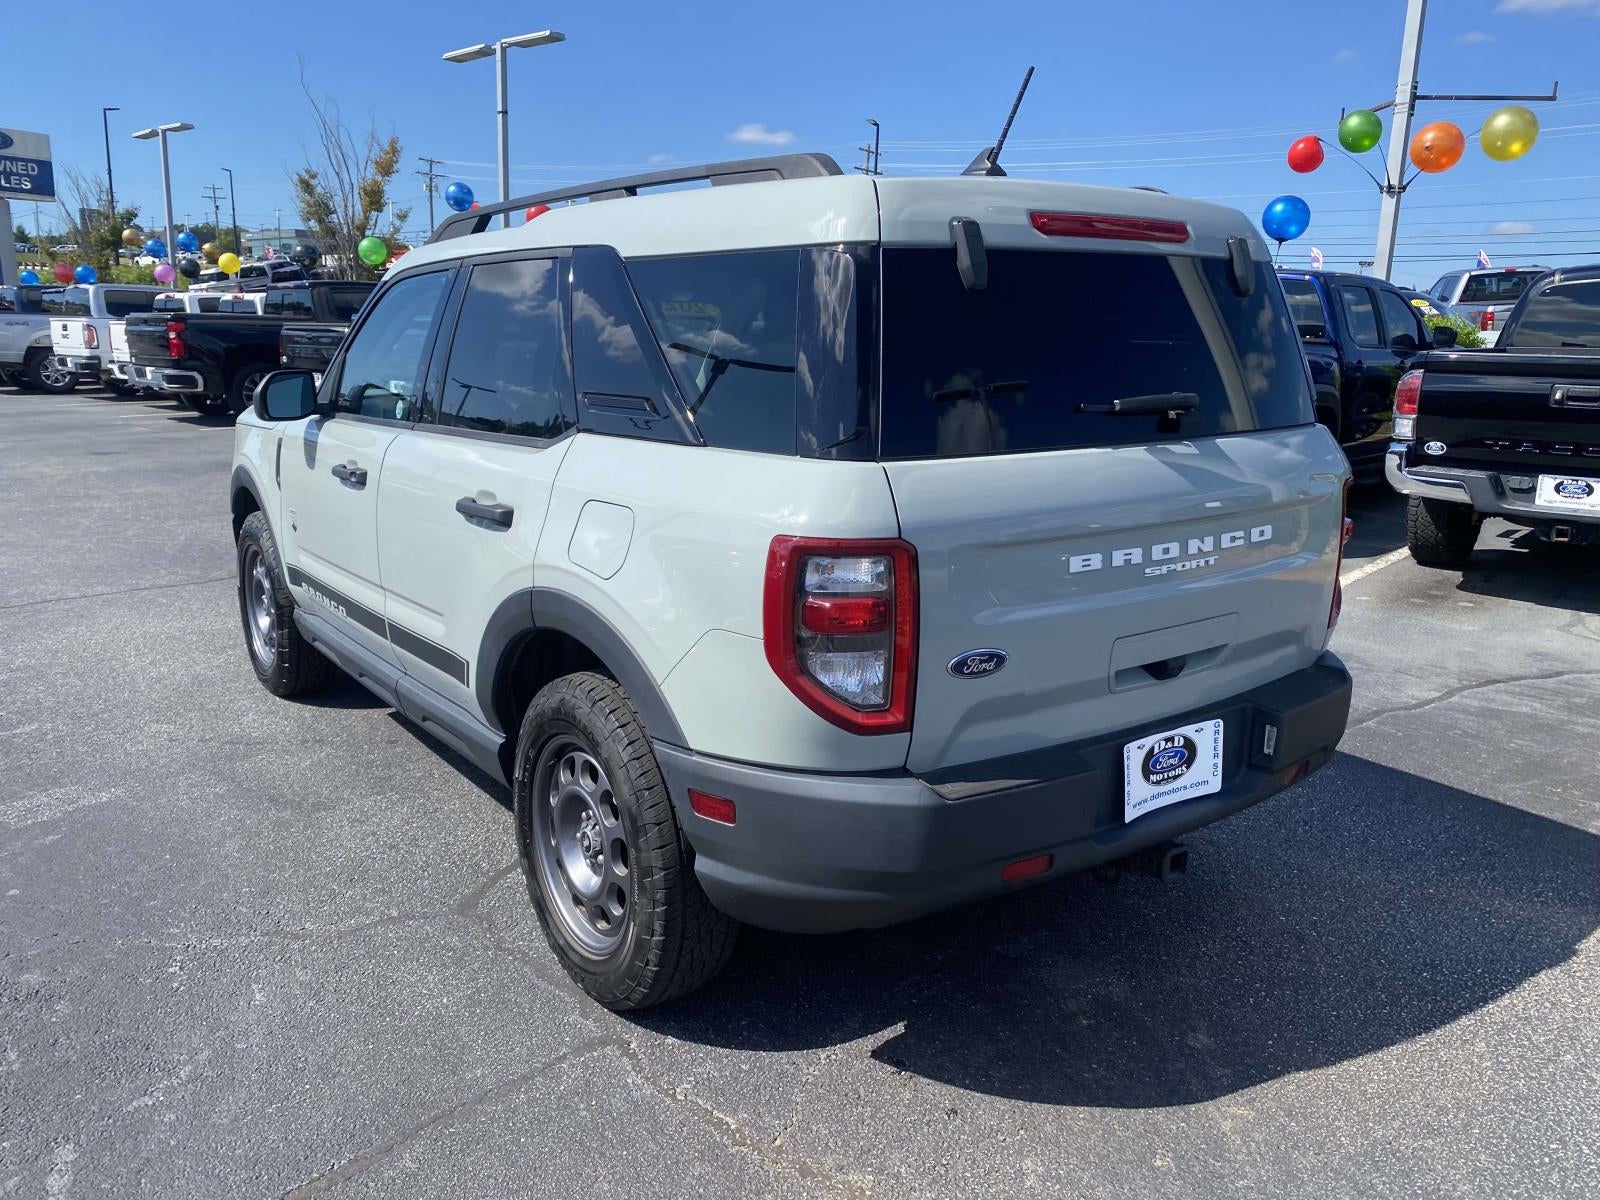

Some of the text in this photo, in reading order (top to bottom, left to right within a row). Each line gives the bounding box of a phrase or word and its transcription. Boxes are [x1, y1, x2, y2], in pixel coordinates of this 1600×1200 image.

[1068, 524, 1273, 574] BRONCO
[1144, 555, 1220, 577] SPORT
[301, 581, 347, 617] BRONCO
[963, 655, 998, 674] Ford
[1152, 735, 1185, 755] D&D
[1156, 750, 1181, 770] Ford
[1149, 763, 1188, 784] MOTORS
[1132, 779, 1210, 809] www.ddmotors.com
